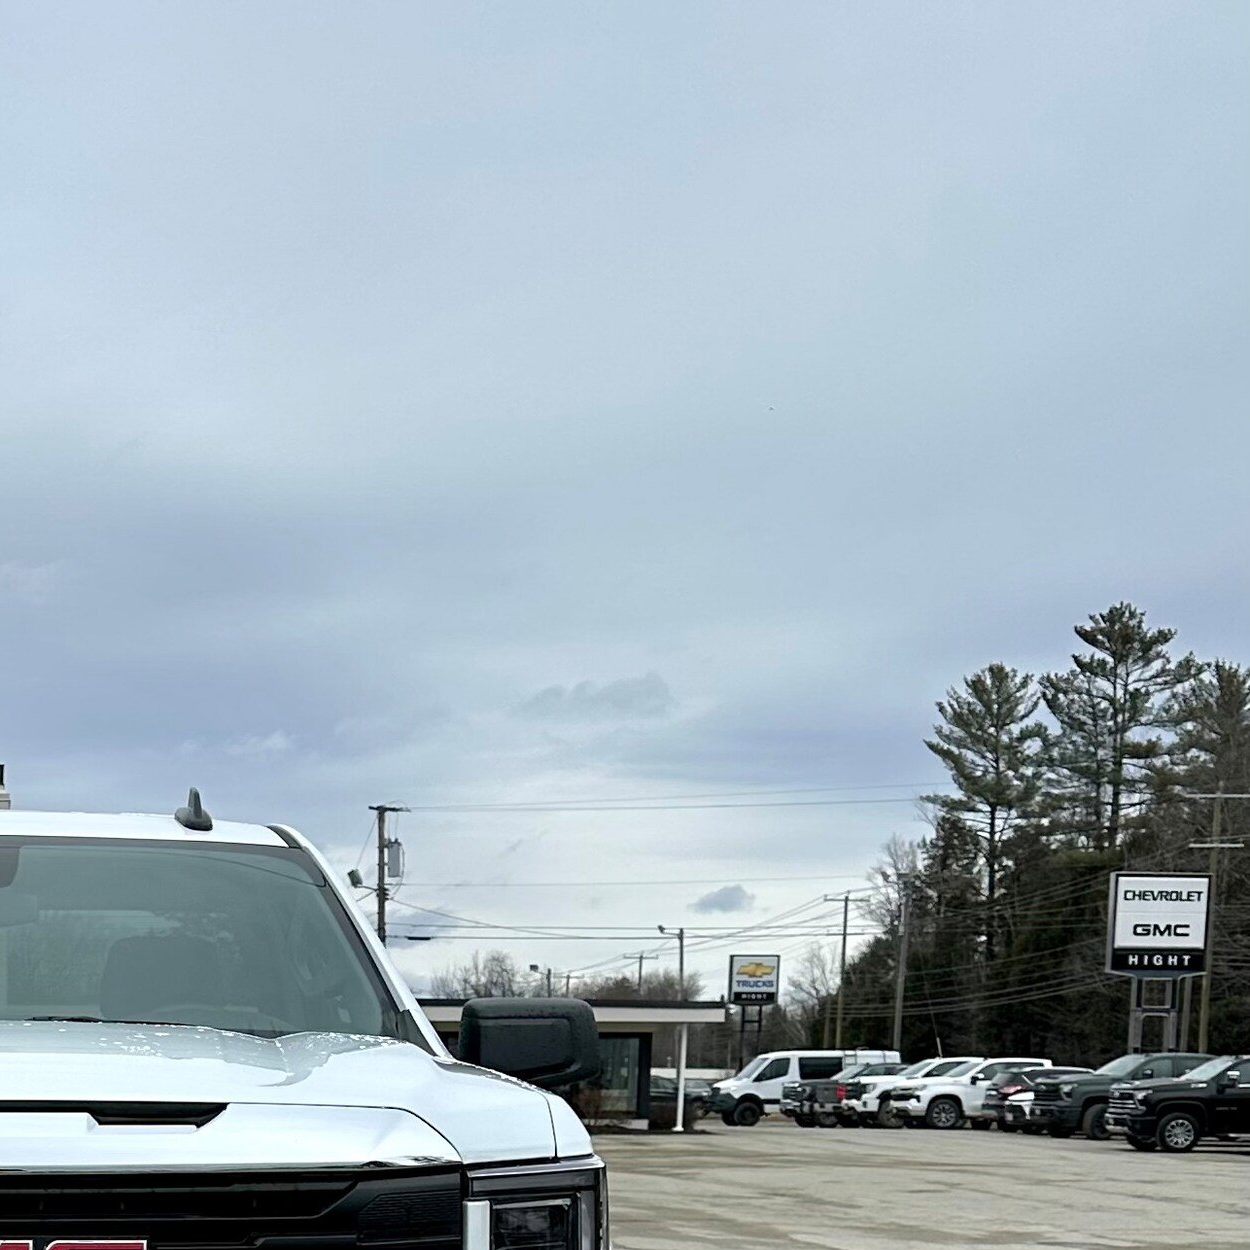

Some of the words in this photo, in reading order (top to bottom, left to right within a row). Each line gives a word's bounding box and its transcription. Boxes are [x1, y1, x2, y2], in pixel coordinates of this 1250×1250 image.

[1123, 889, 1204, 902] CHEVROLET
[1132, 923, 1191, 937] GMC
[1128, 954, 1192, 966] HIGHT
[736, 980, 775, 988] TRUCKS
